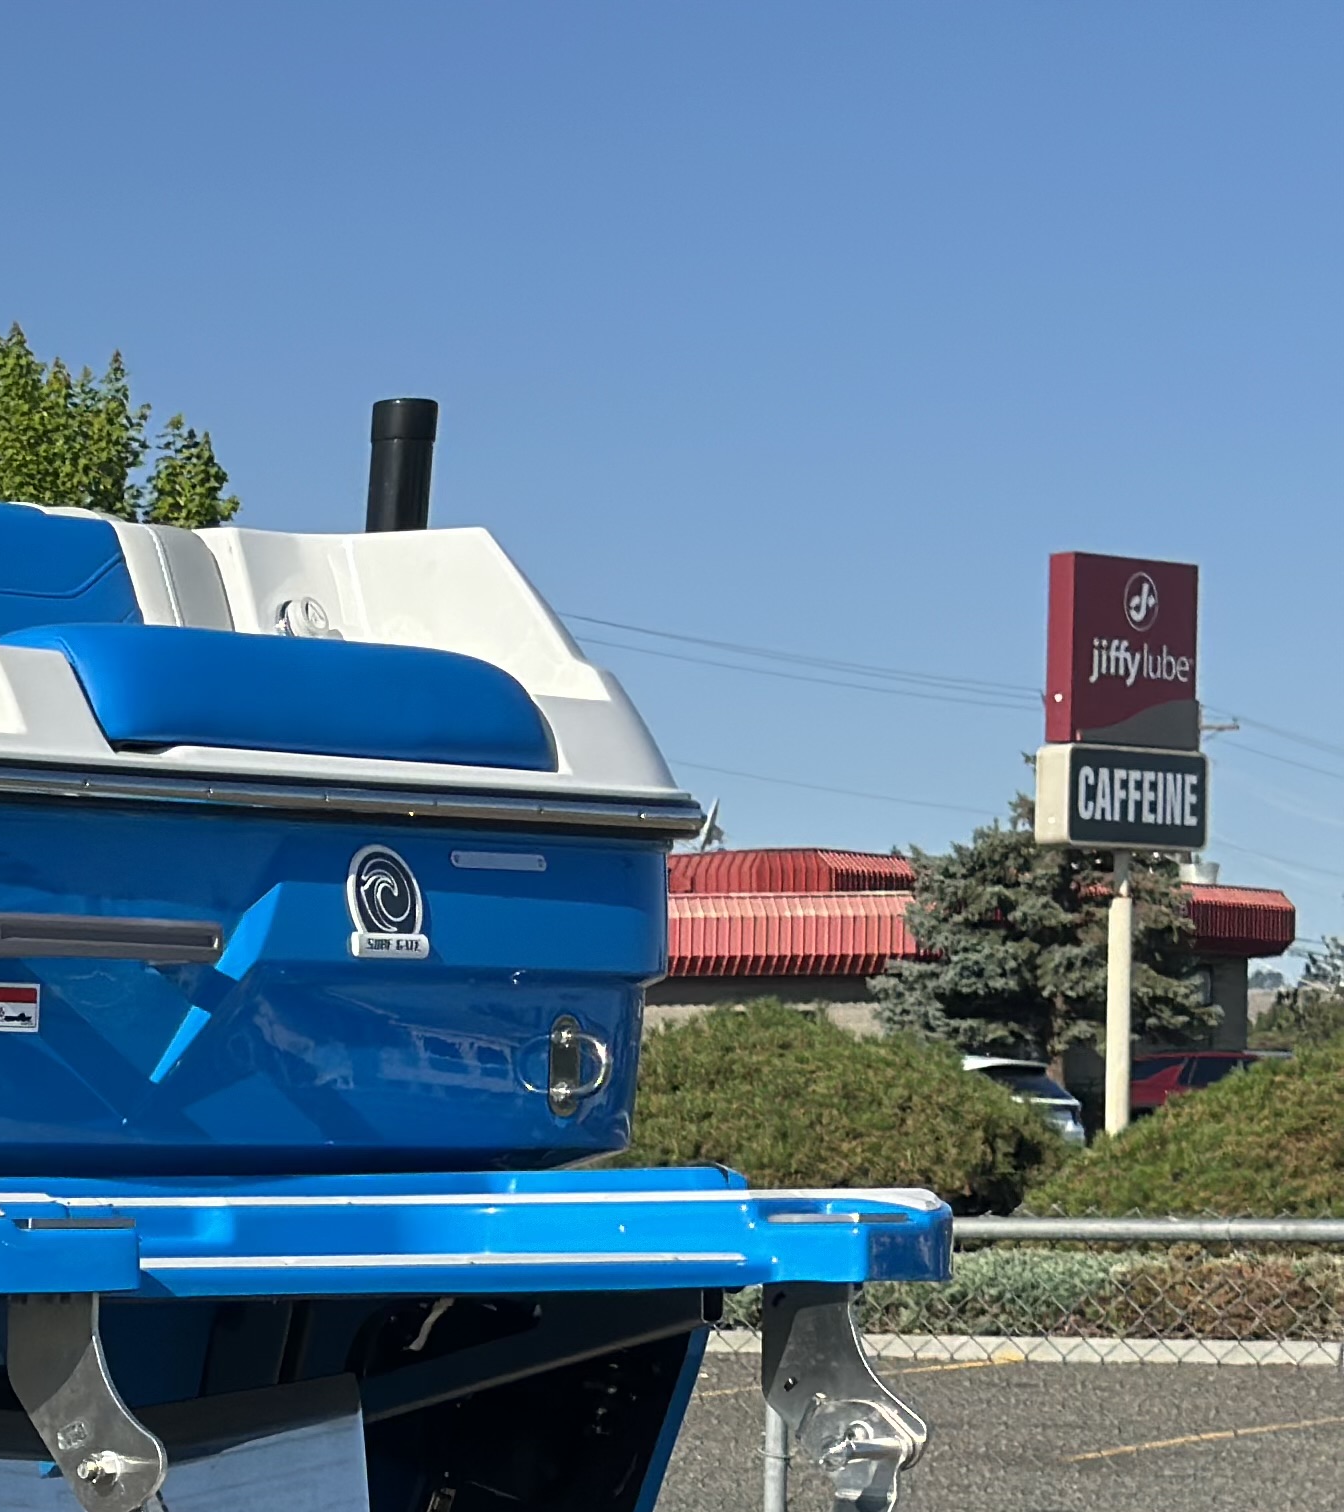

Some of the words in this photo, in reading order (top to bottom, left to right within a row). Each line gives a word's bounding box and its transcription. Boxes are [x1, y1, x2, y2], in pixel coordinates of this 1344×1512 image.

[1089, 637, 1141, 687] jiffy
[1143, 642, 1190, 683] lube
[1077, 765, 1198, 827] CAFFEINE
[367, 938, 391, 951] SURF
[396, 938, 421, 952] GATE
